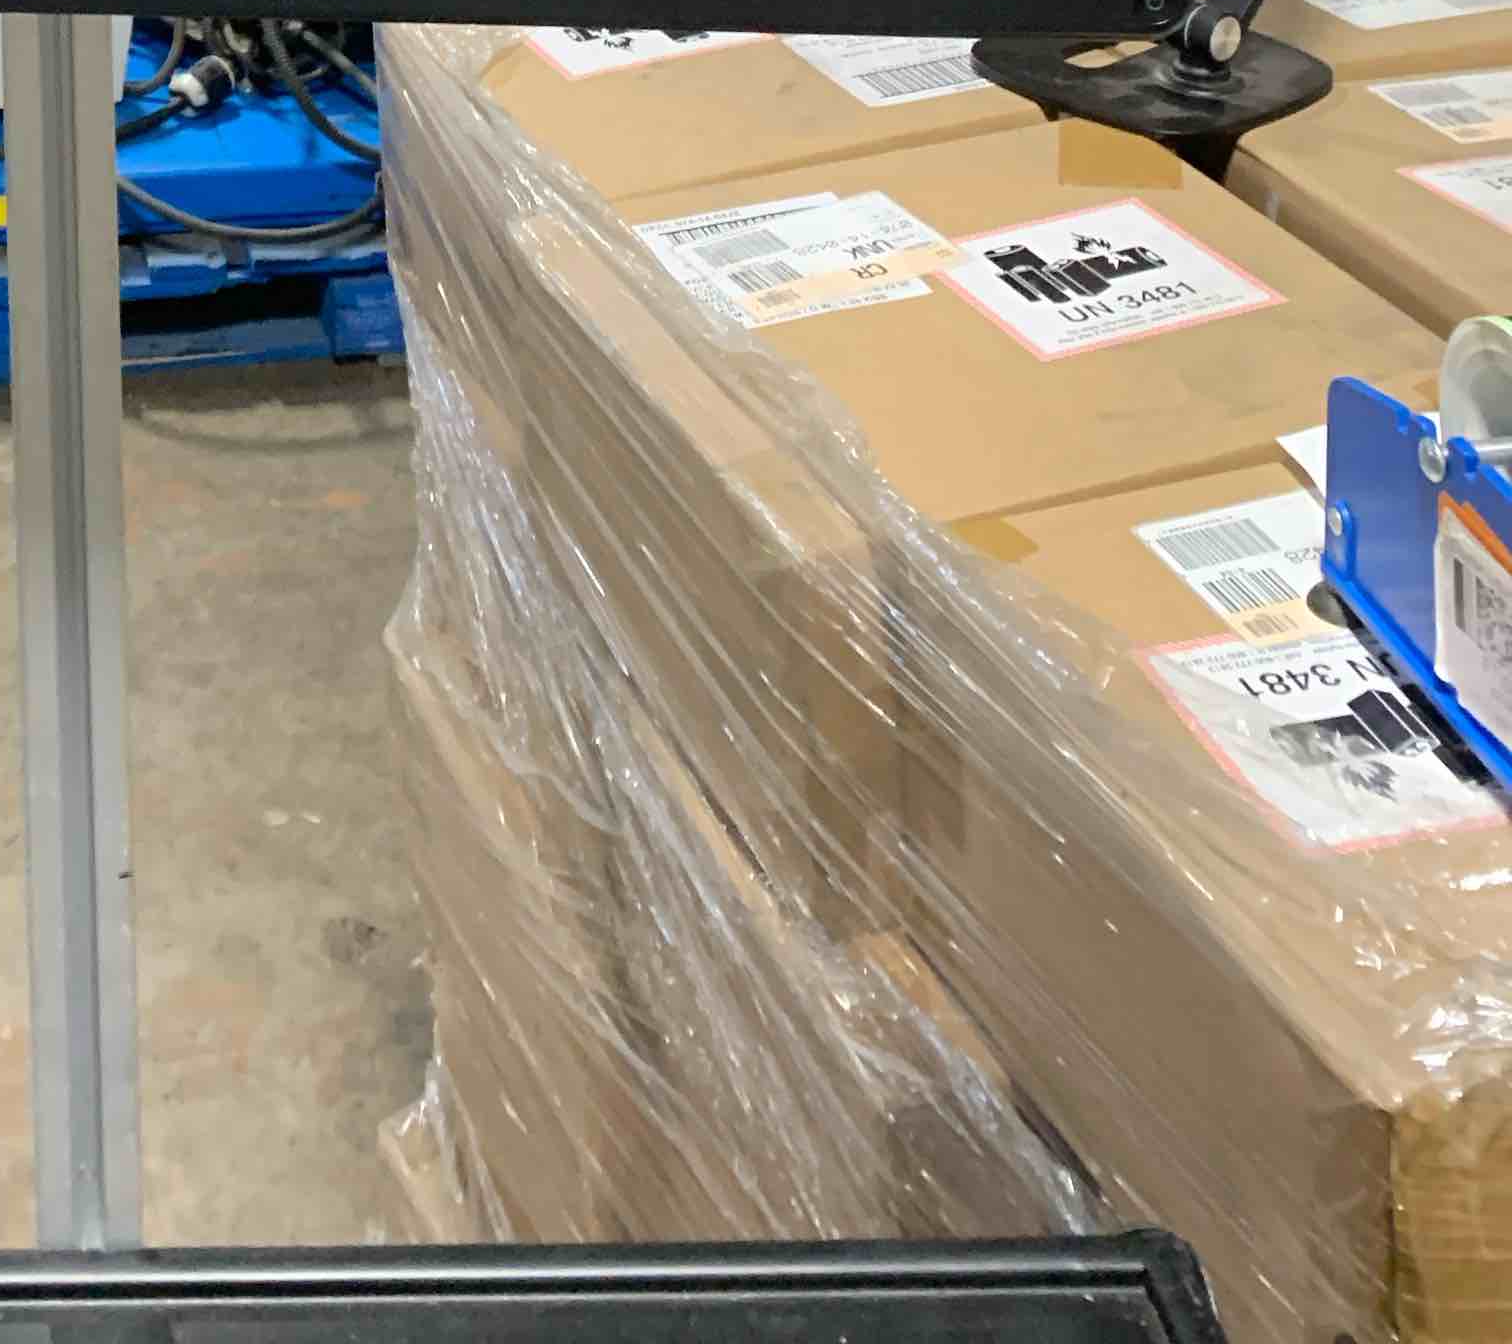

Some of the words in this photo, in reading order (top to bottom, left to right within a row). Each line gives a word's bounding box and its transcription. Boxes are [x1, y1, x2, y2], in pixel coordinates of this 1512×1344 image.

[1057, 299, 1116, 324] UN
[1117, 279, 1198, 312] 3481
[1237, 663, 1341, 698] 3481
